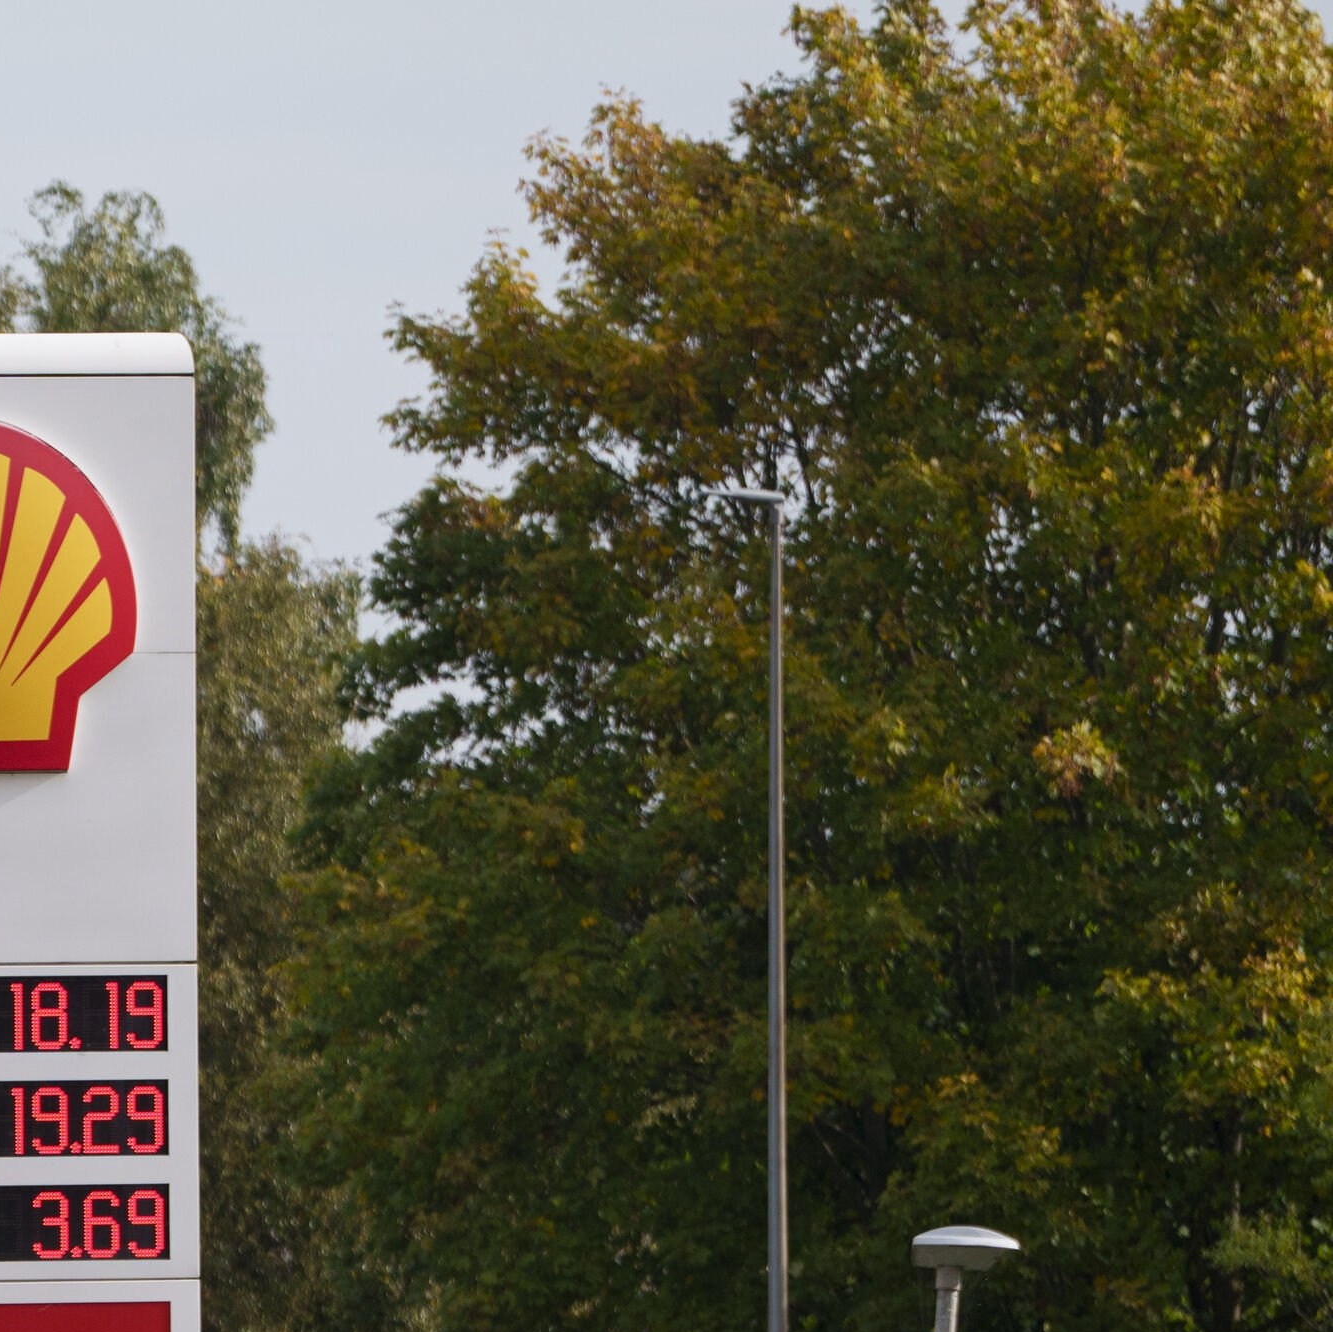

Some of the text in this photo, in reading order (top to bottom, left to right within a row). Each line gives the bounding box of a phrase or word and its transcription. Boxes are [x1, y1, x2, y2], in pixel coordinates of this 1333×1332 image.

[10, 981, 163, 1051] 18.19
[11, 1086, 165, 1155] 19.29
[32, 1189, 165, 1259] 3.69
